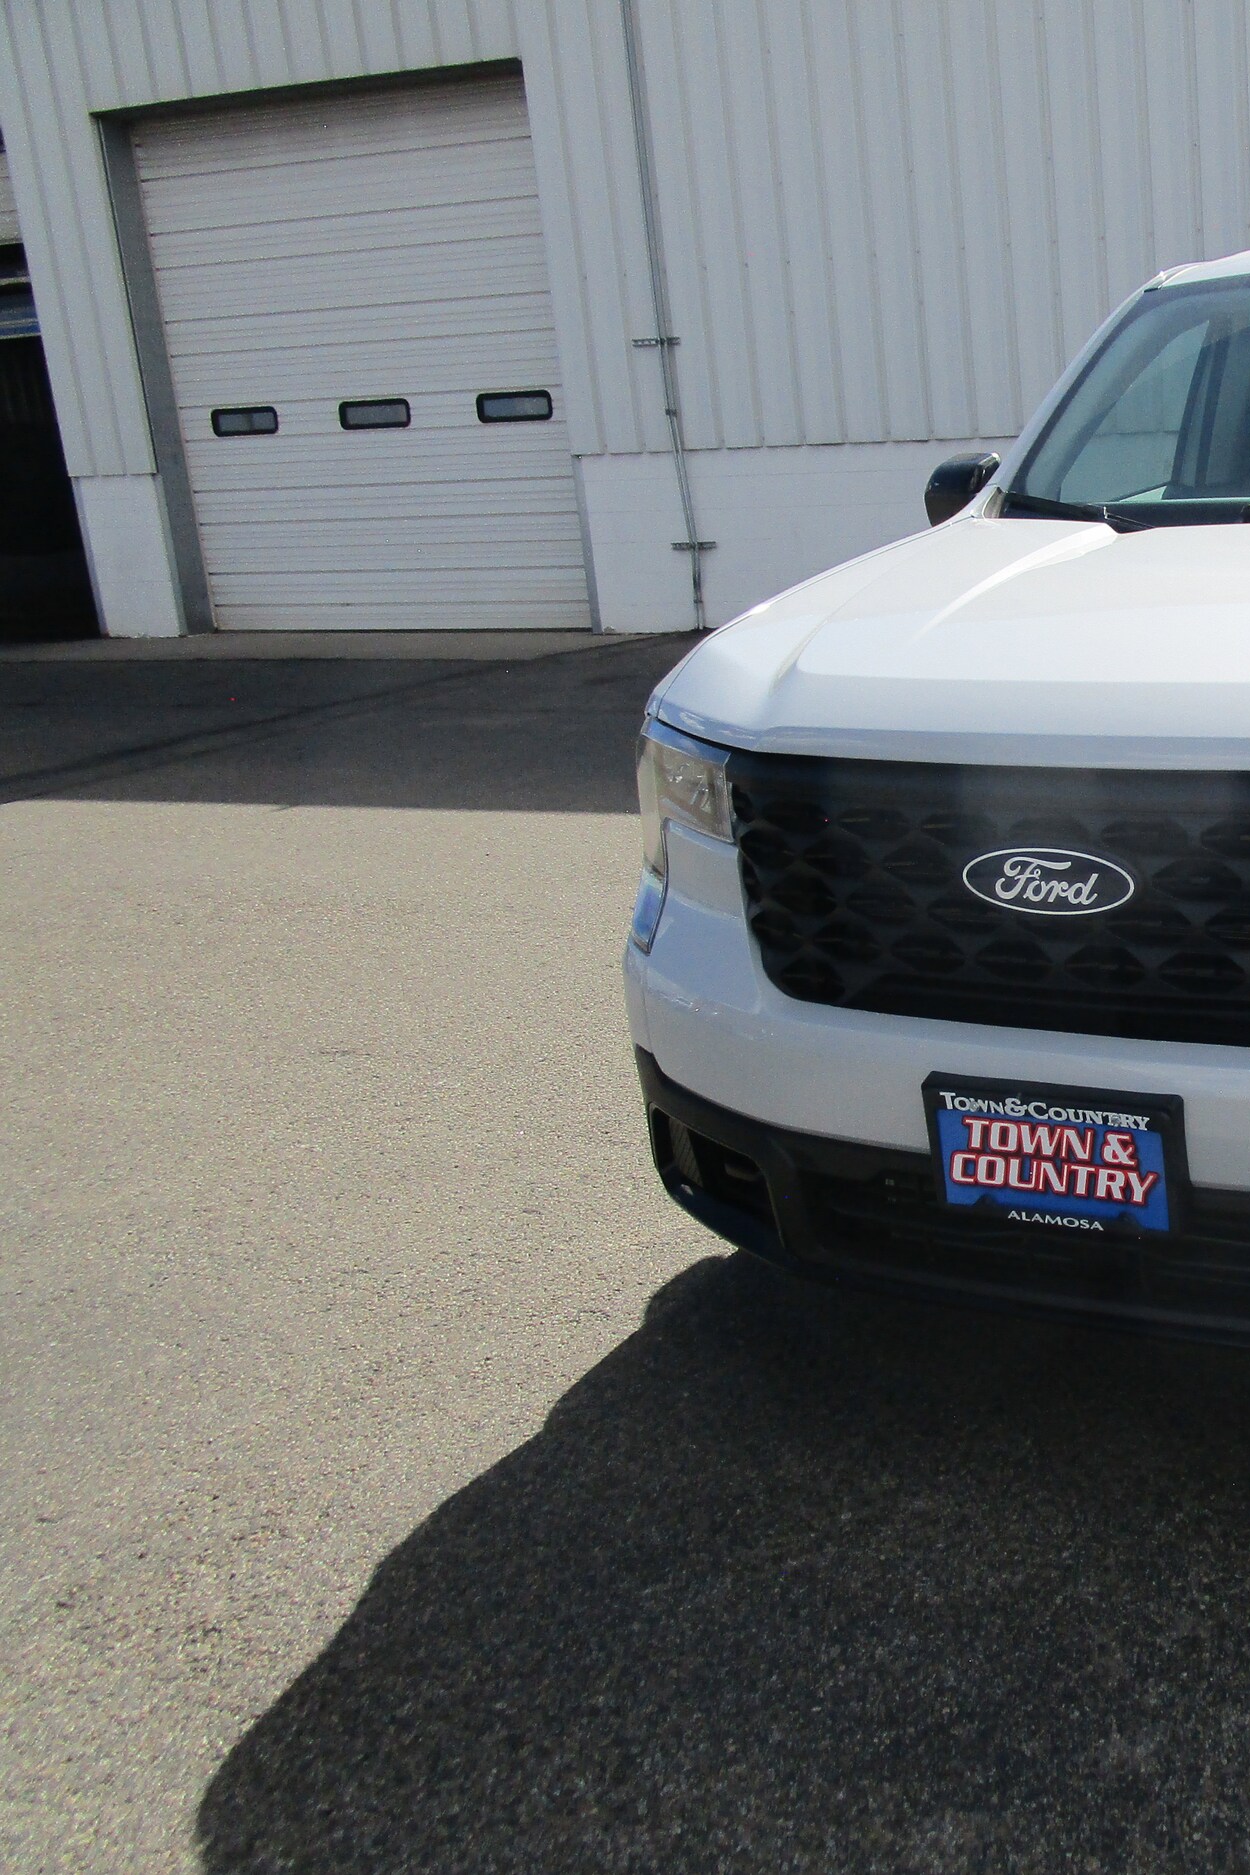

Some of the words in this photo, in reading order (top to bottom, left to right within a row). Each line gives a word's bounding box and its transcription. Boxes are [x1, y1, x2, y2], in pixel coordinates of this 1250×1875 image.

[995, 856, 1099, 905] Ford
[962, 1116, 1094, 1161] TOWN
[1102, 1131, 1138, 1168] &
[951, 1151, 1158, 1206] COUNTRY
[1008, 1210, 1104, 1231] ALAMOSA
